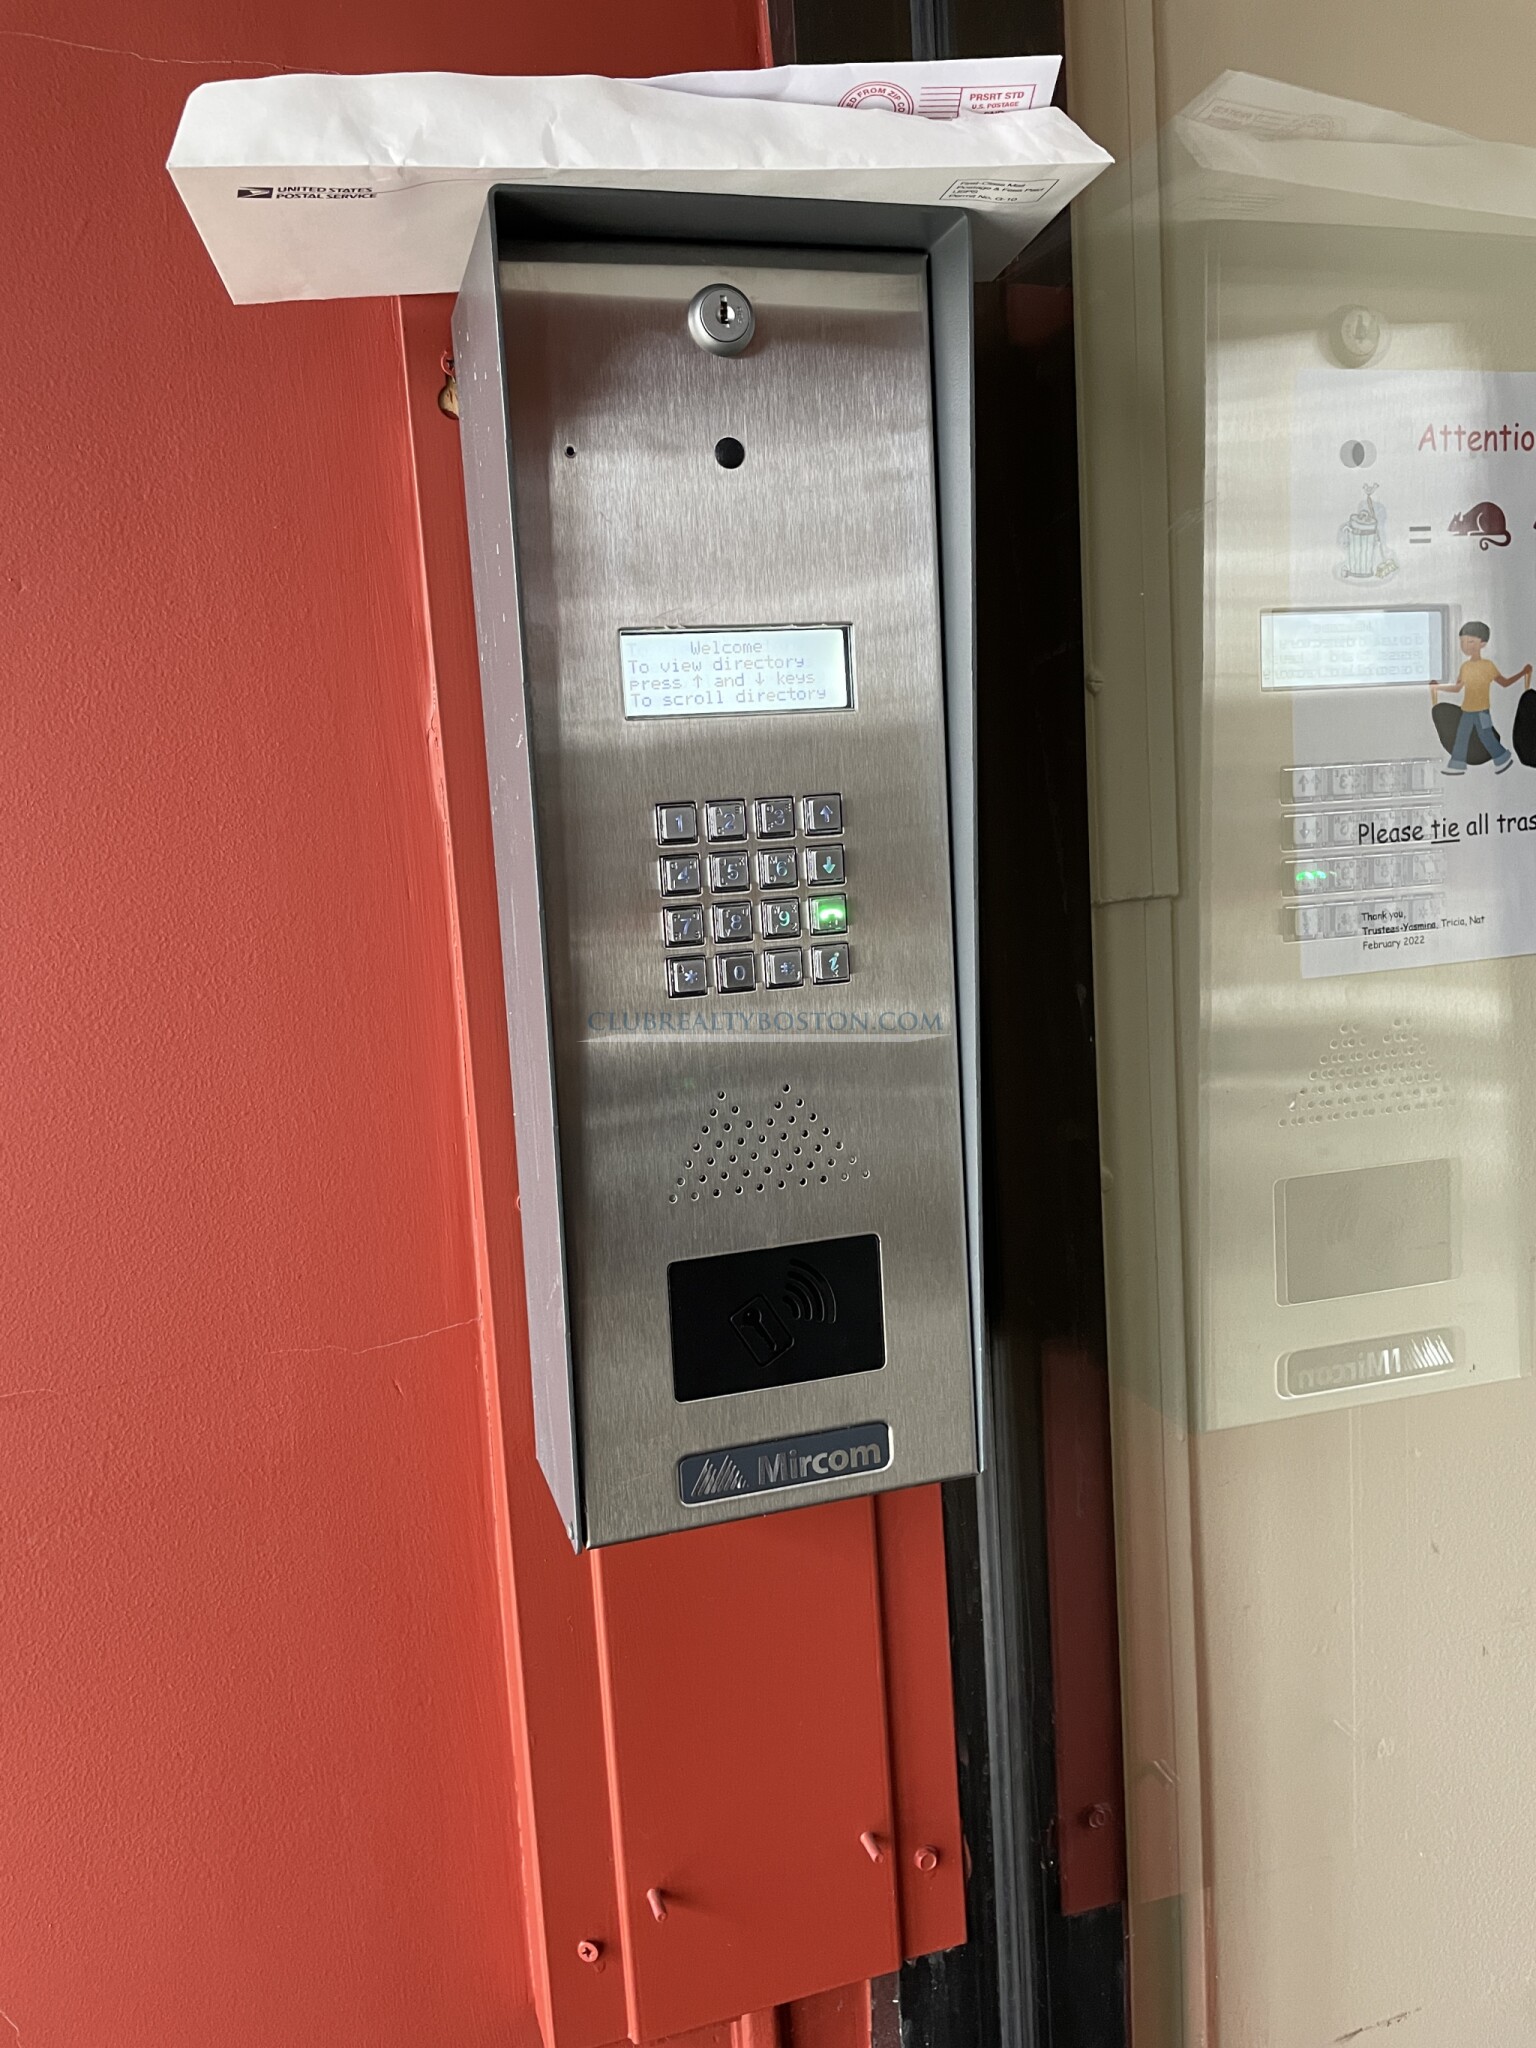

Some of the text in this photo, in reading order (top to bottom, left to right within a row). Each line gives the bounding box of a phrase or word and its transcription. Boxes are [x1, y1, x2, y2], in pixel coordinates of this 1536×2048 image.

[857, 87, 887, 98] FROM
[887, 90, 902, 101] ZIP
[969, 91, 1025, 101] PRSRT STD
[987, 101, 1020, 109] POSTAGE
[1418, 422, 1535, 452] Attentio
[689, 641, 763, 655] Welcome
[628, 655, 805, 674] To view directory
[629, 671, 816, 691] press and keys
[631, 687, 826, 708] To scroll directory
[674, 814, 683, 832] 1
[723, 812, 736, 831] 2
[773, 809, 786, 826] 3
[1358, 822, 1425, 845] Please
[1431, 818, 1460, 843] tie
[1466, 813, 1488, 836] all
[1497, 813, 1536, 833] tras
[726, 863, 739, 881] 5
[775, 861, 788, 877] 6
[680, 917, 692, 936] 7
[730, 914, 742, 931] 8
[778, 910, 791, 927] 9
[1361, 910, 1406, 921] Thank you,
[1441, 918, 1467, 928] Tricia,
[1469, 915, 1485, 926] Nat
[1362, 935, 1425, 951] February 2022
[758, 1442, 881, 1486] Mircom
